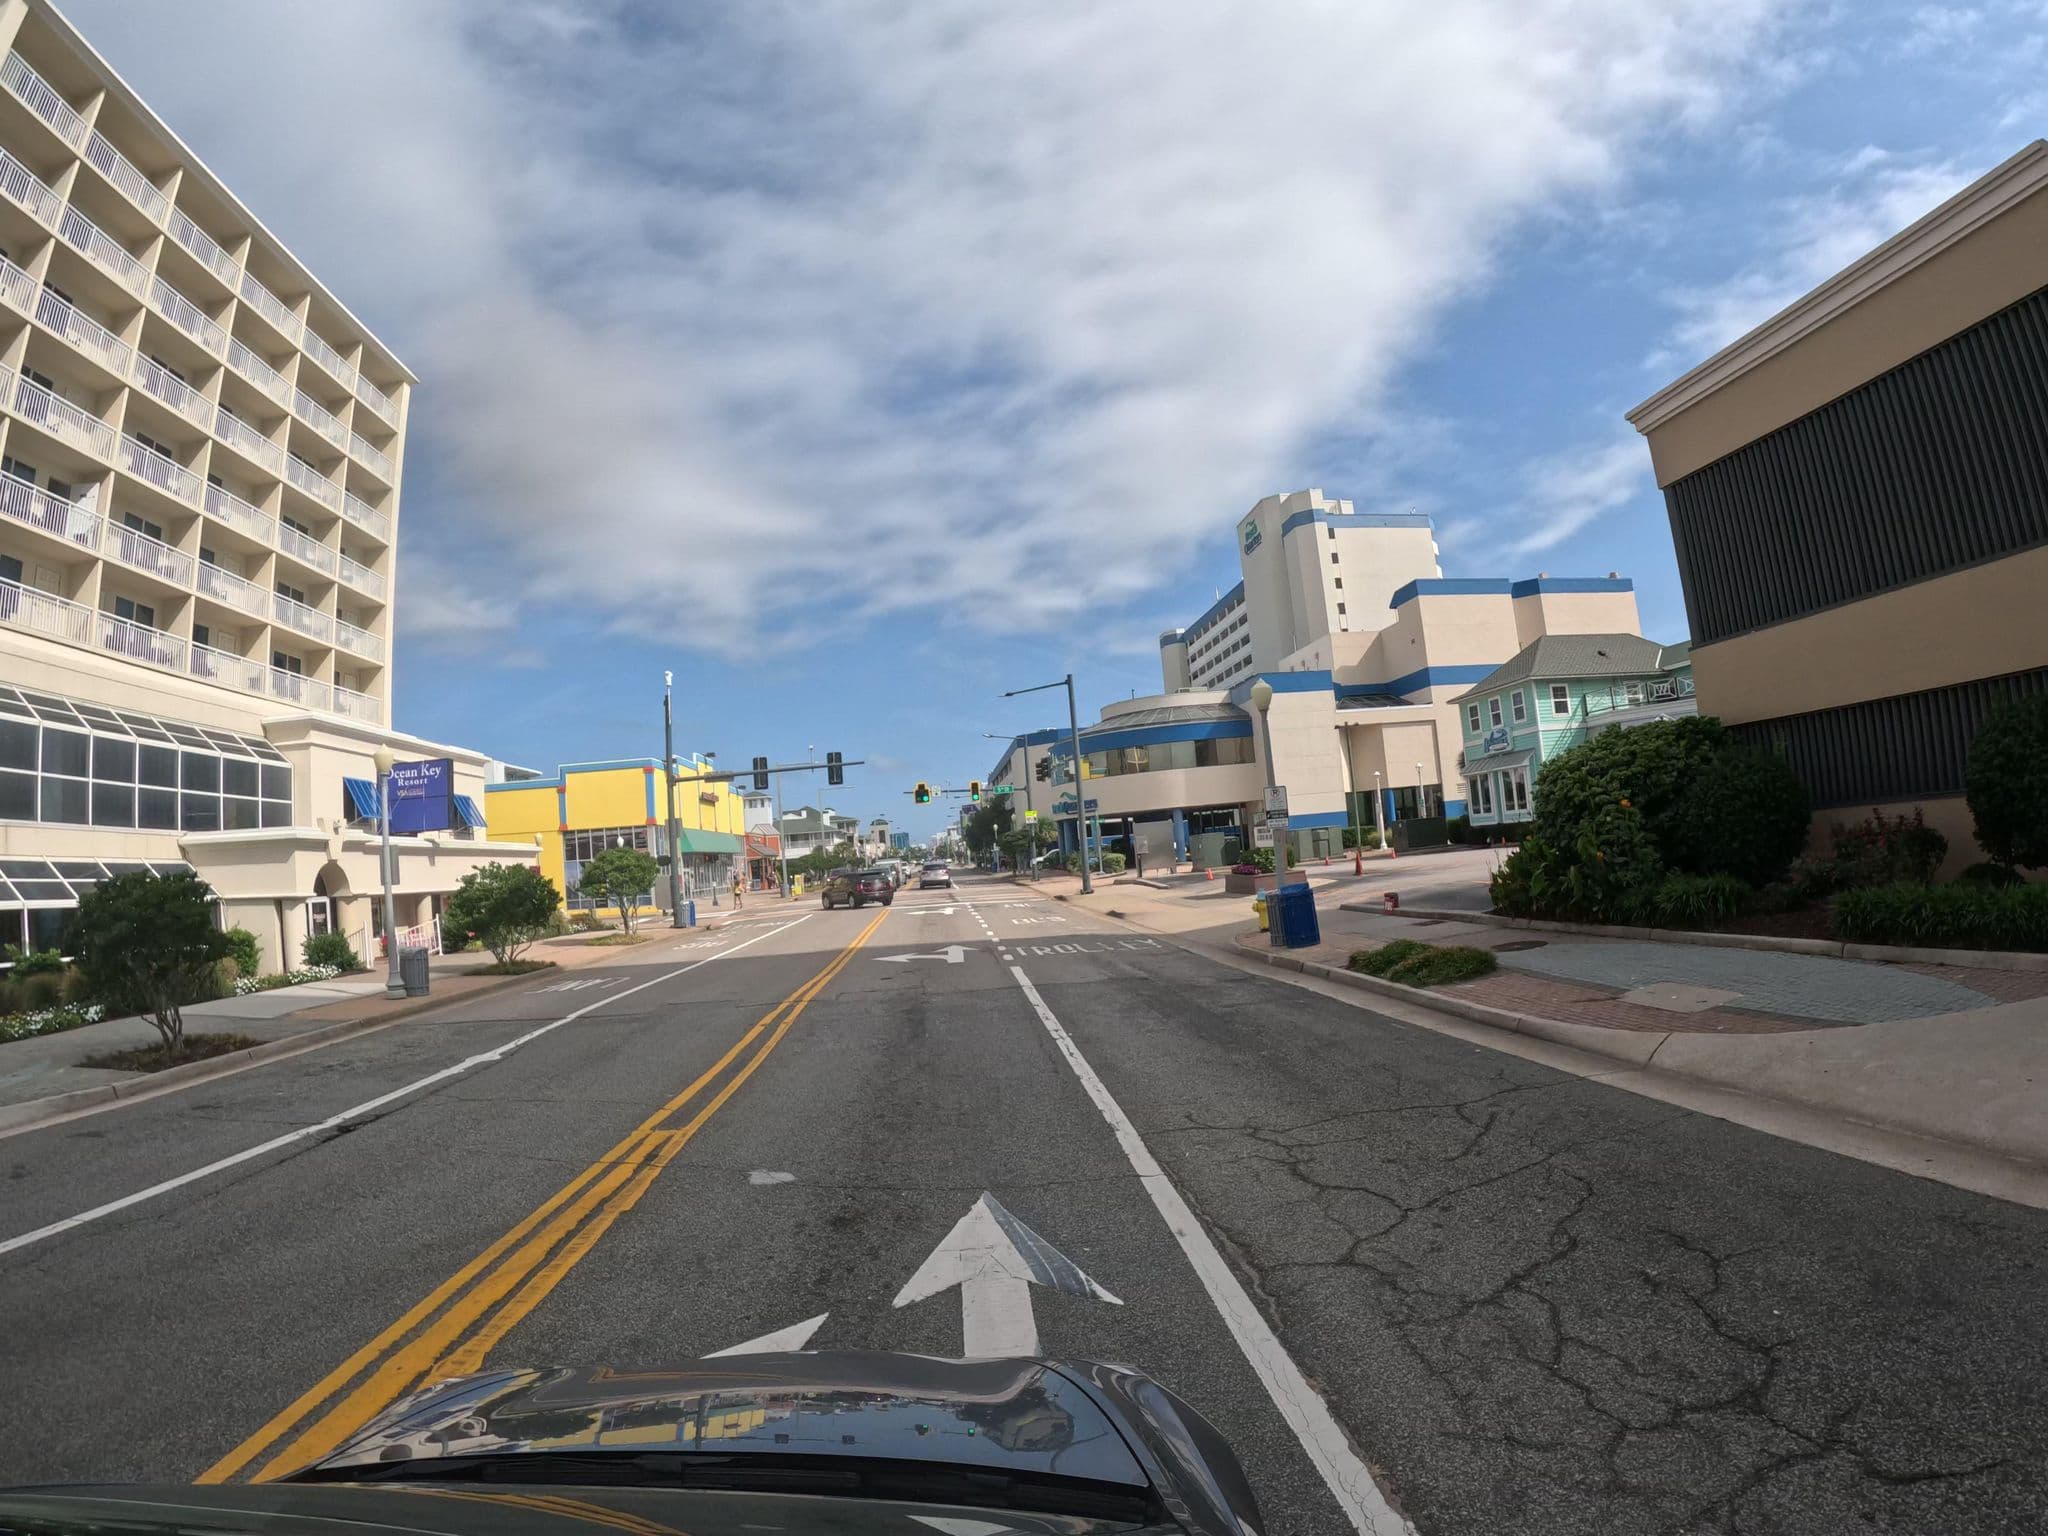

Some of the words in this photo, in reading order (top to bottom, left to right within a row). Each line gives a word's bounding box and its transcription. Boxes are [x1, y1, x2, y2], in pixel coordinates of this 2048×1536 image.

[421, 764, 441, 778] Key
[398, 778, 427, 786] Resort
[1015, 938, 1162, 956] TROLLEY
